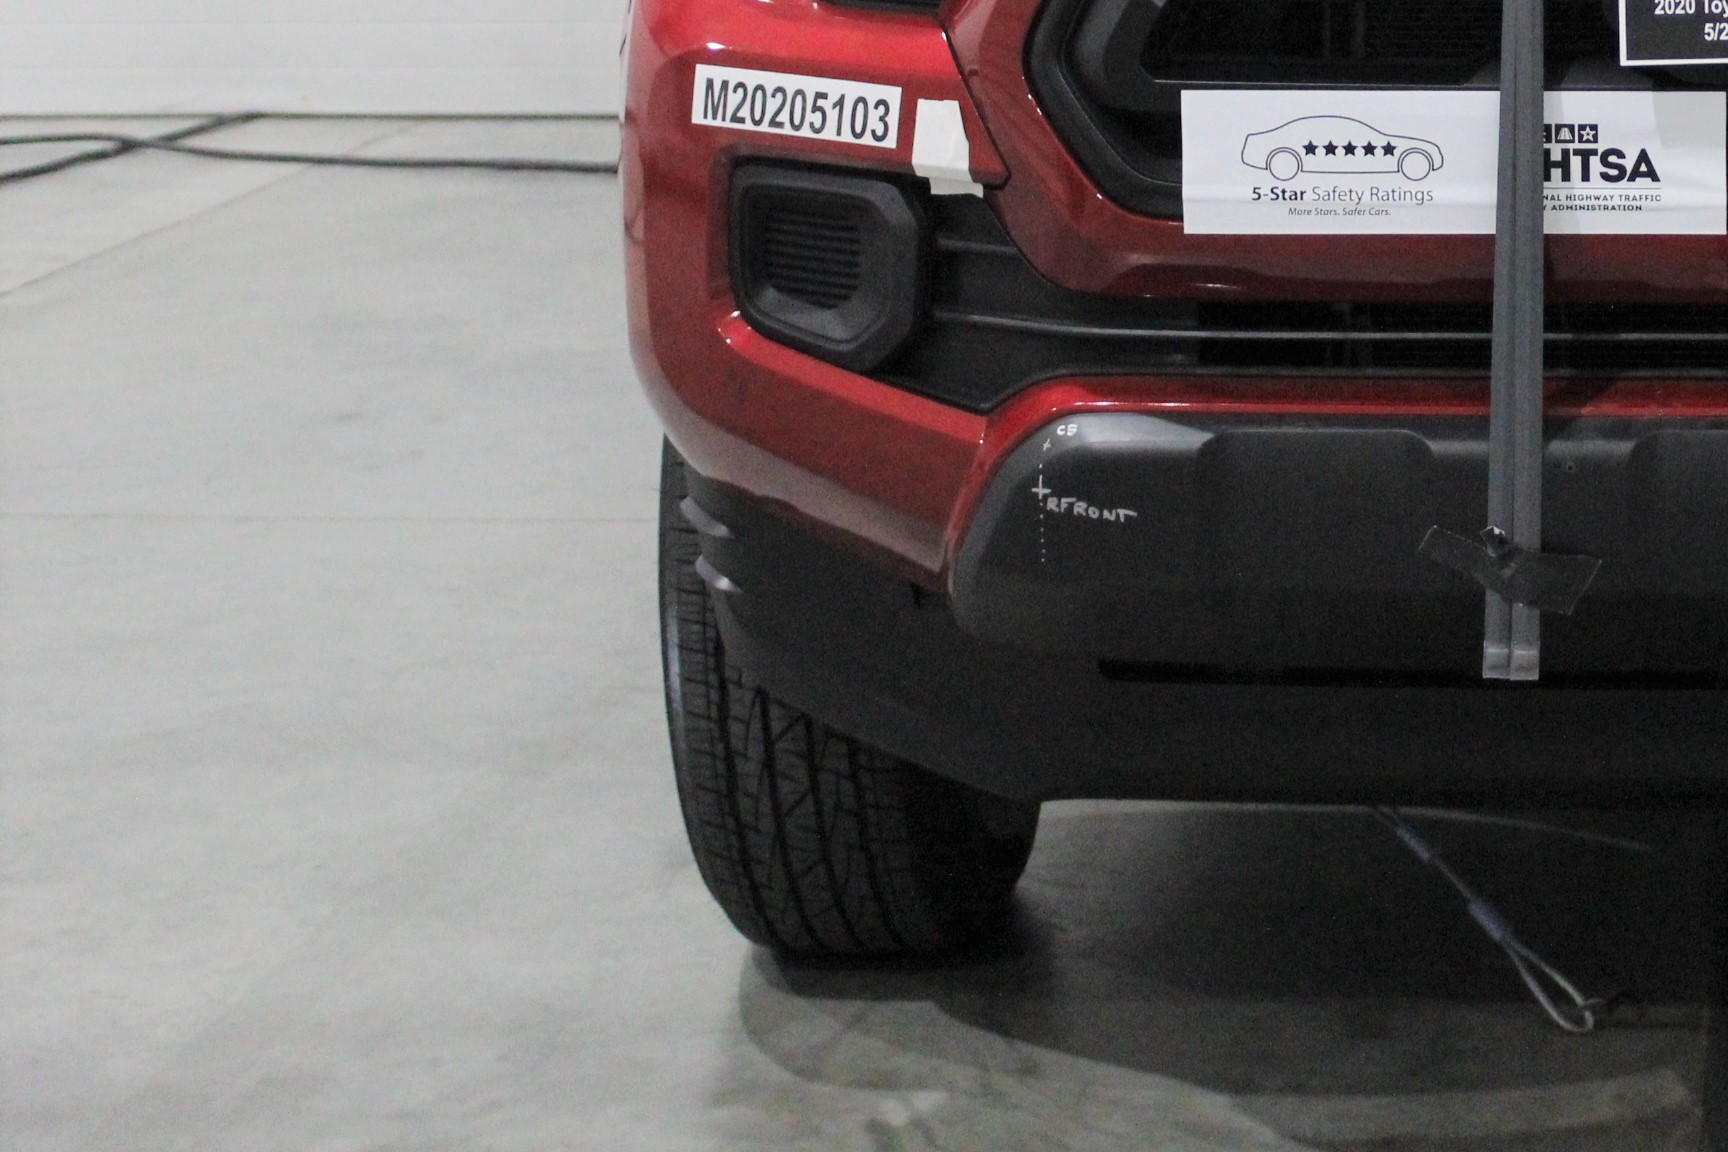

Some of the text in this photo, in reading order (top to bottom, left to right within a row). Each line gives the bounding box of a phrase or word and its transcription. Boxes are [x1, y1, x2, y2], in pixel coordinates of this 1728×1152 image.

[703, 77, 890, 143] M20205103
[1543, 147, 1661, 185] HTSA
[1251, 186, 1434, 206] 5-Star Safety Ratings
[1565, 193, 1615, 202] HIGHWAY
[1618, 193, 1662, 202] TRAFFIC
[1288, 207, 1392, 216] More Stars. Safer Cars.
[1550, 203, 1643, 212] ADMINISTRATION
[1046, 496, 1138, 523] RFRONT
